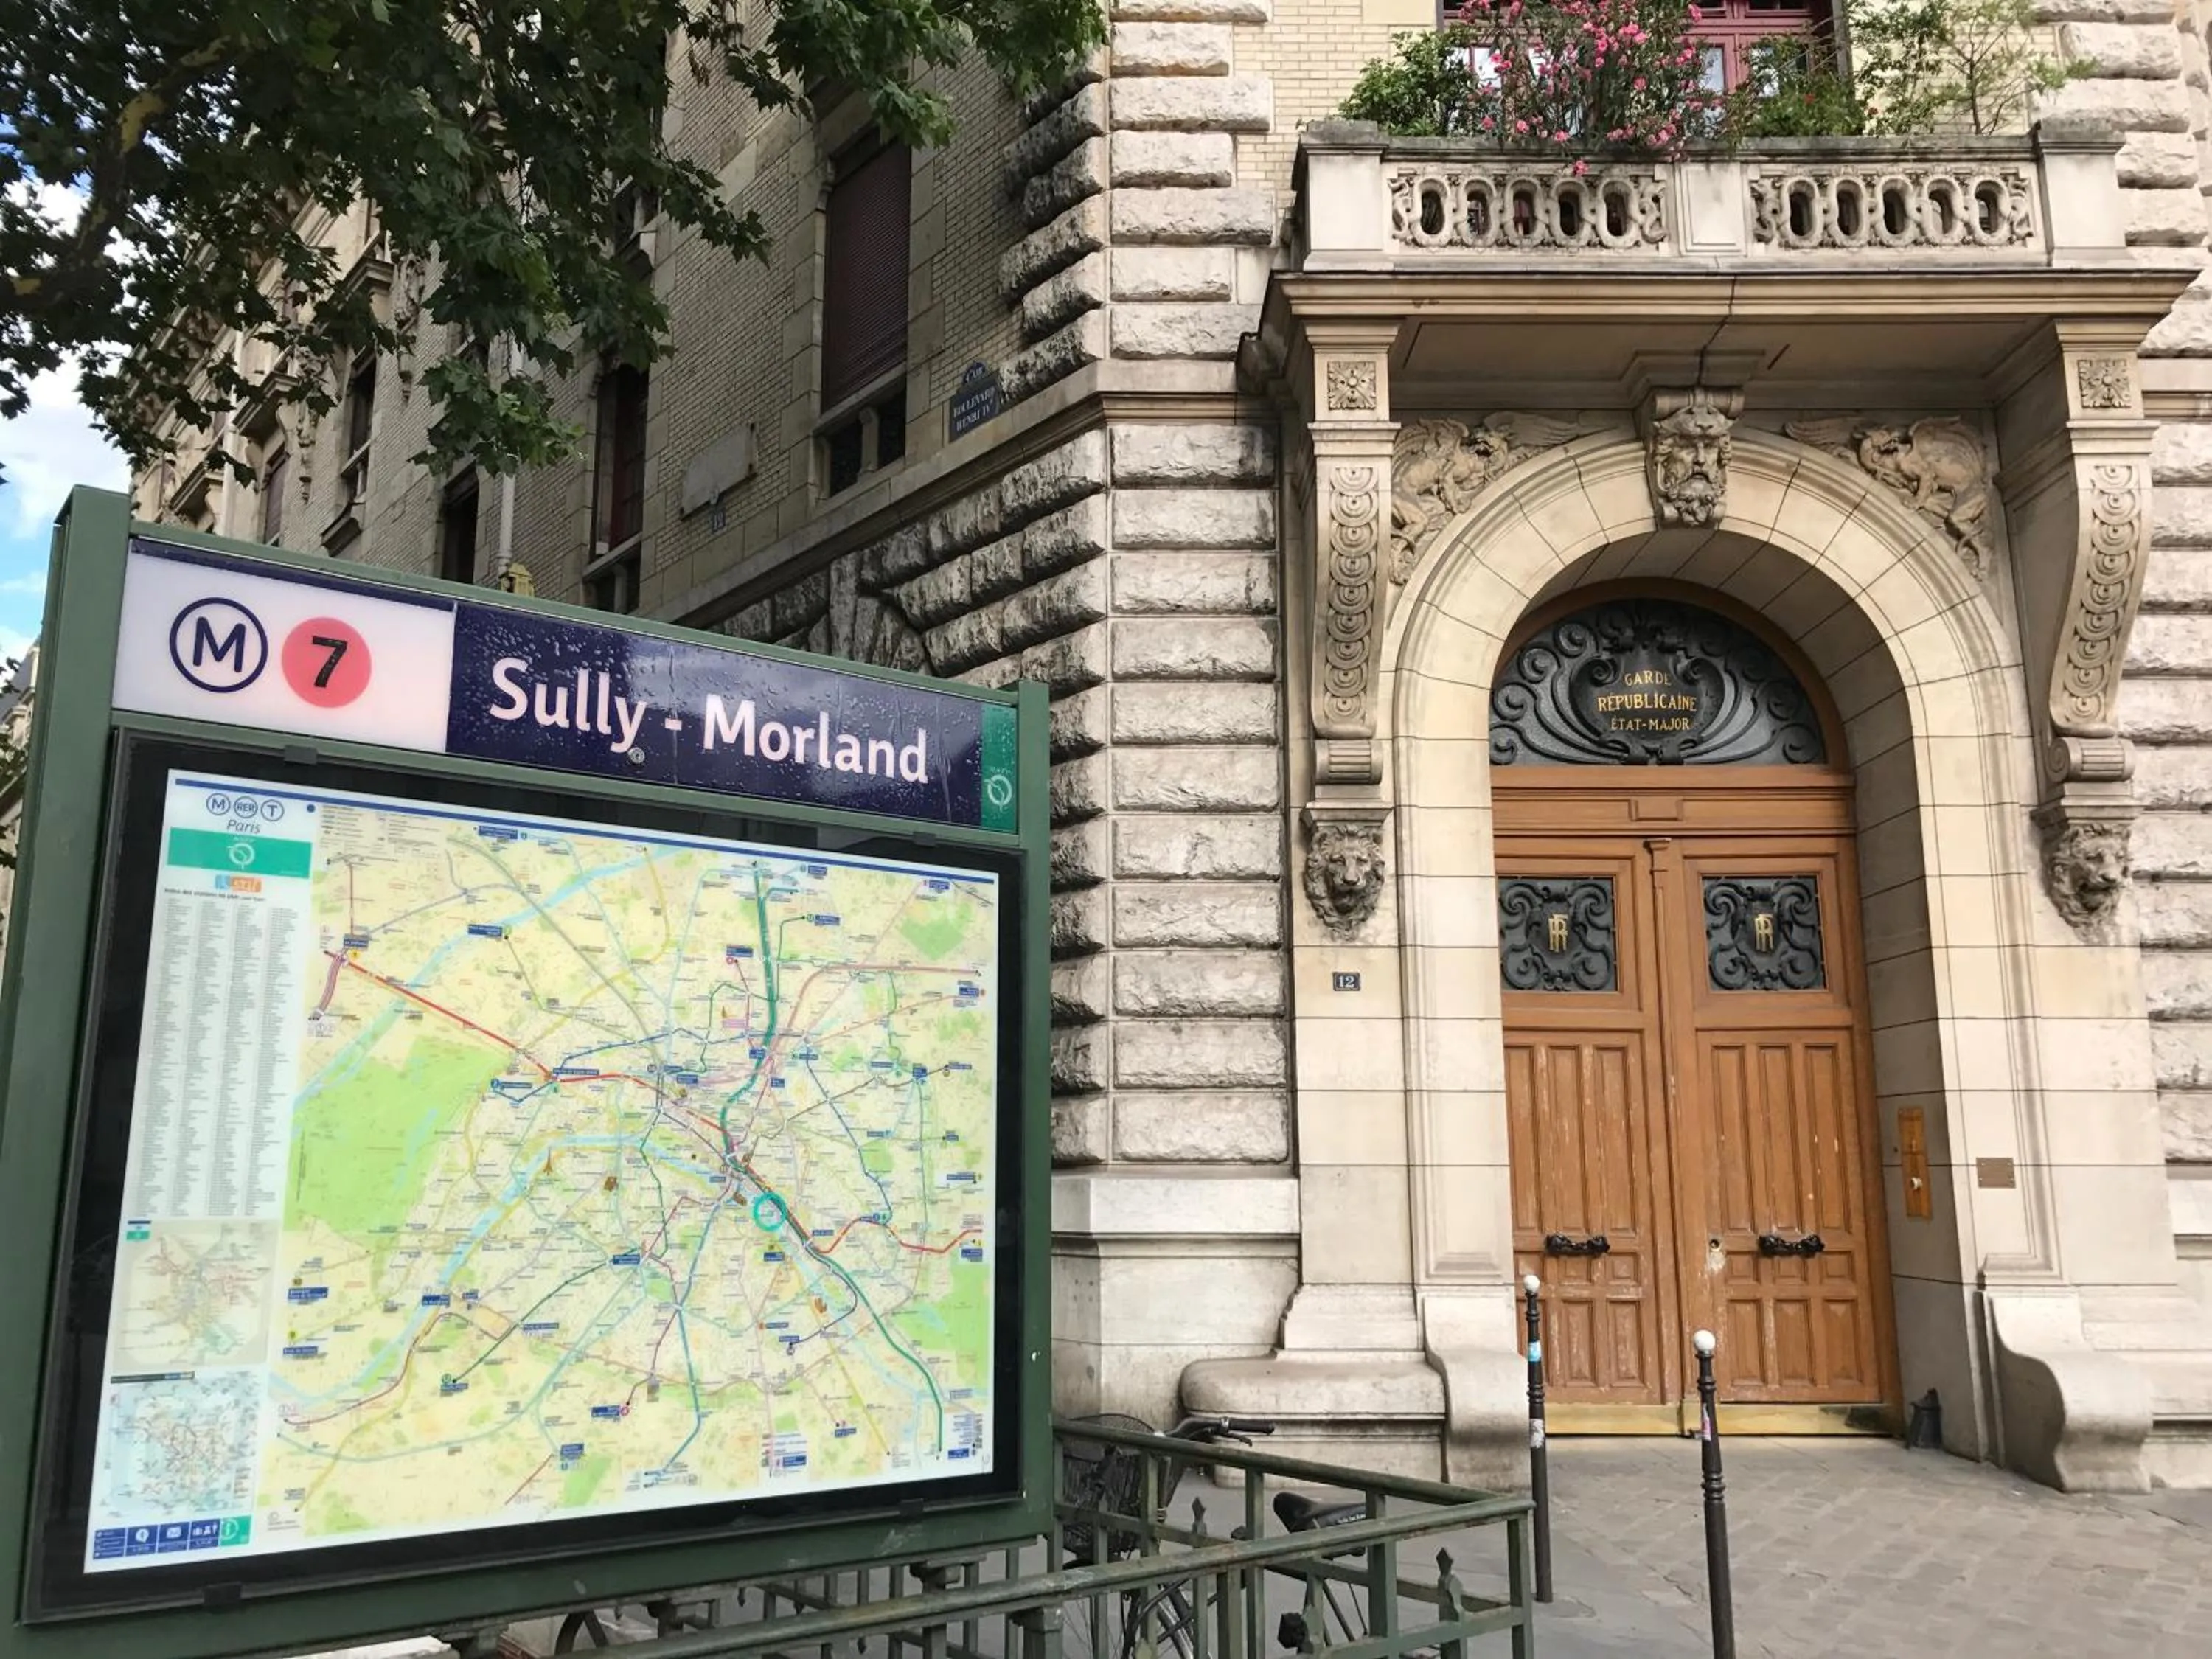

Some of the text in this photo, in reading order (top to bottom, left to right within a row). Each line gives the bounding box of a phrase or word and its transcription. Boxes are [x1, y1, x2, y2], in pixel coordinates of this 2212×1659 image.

[193, 616, 348, 688] M 7
[1624, 670, 1672, 686] GARDE
[490, 657, 647, 754] Sully
[704, 693, 928, 784] Morland
[226, 819, 260, 835] Paris
[1339, 975, 1354, 988] 12
